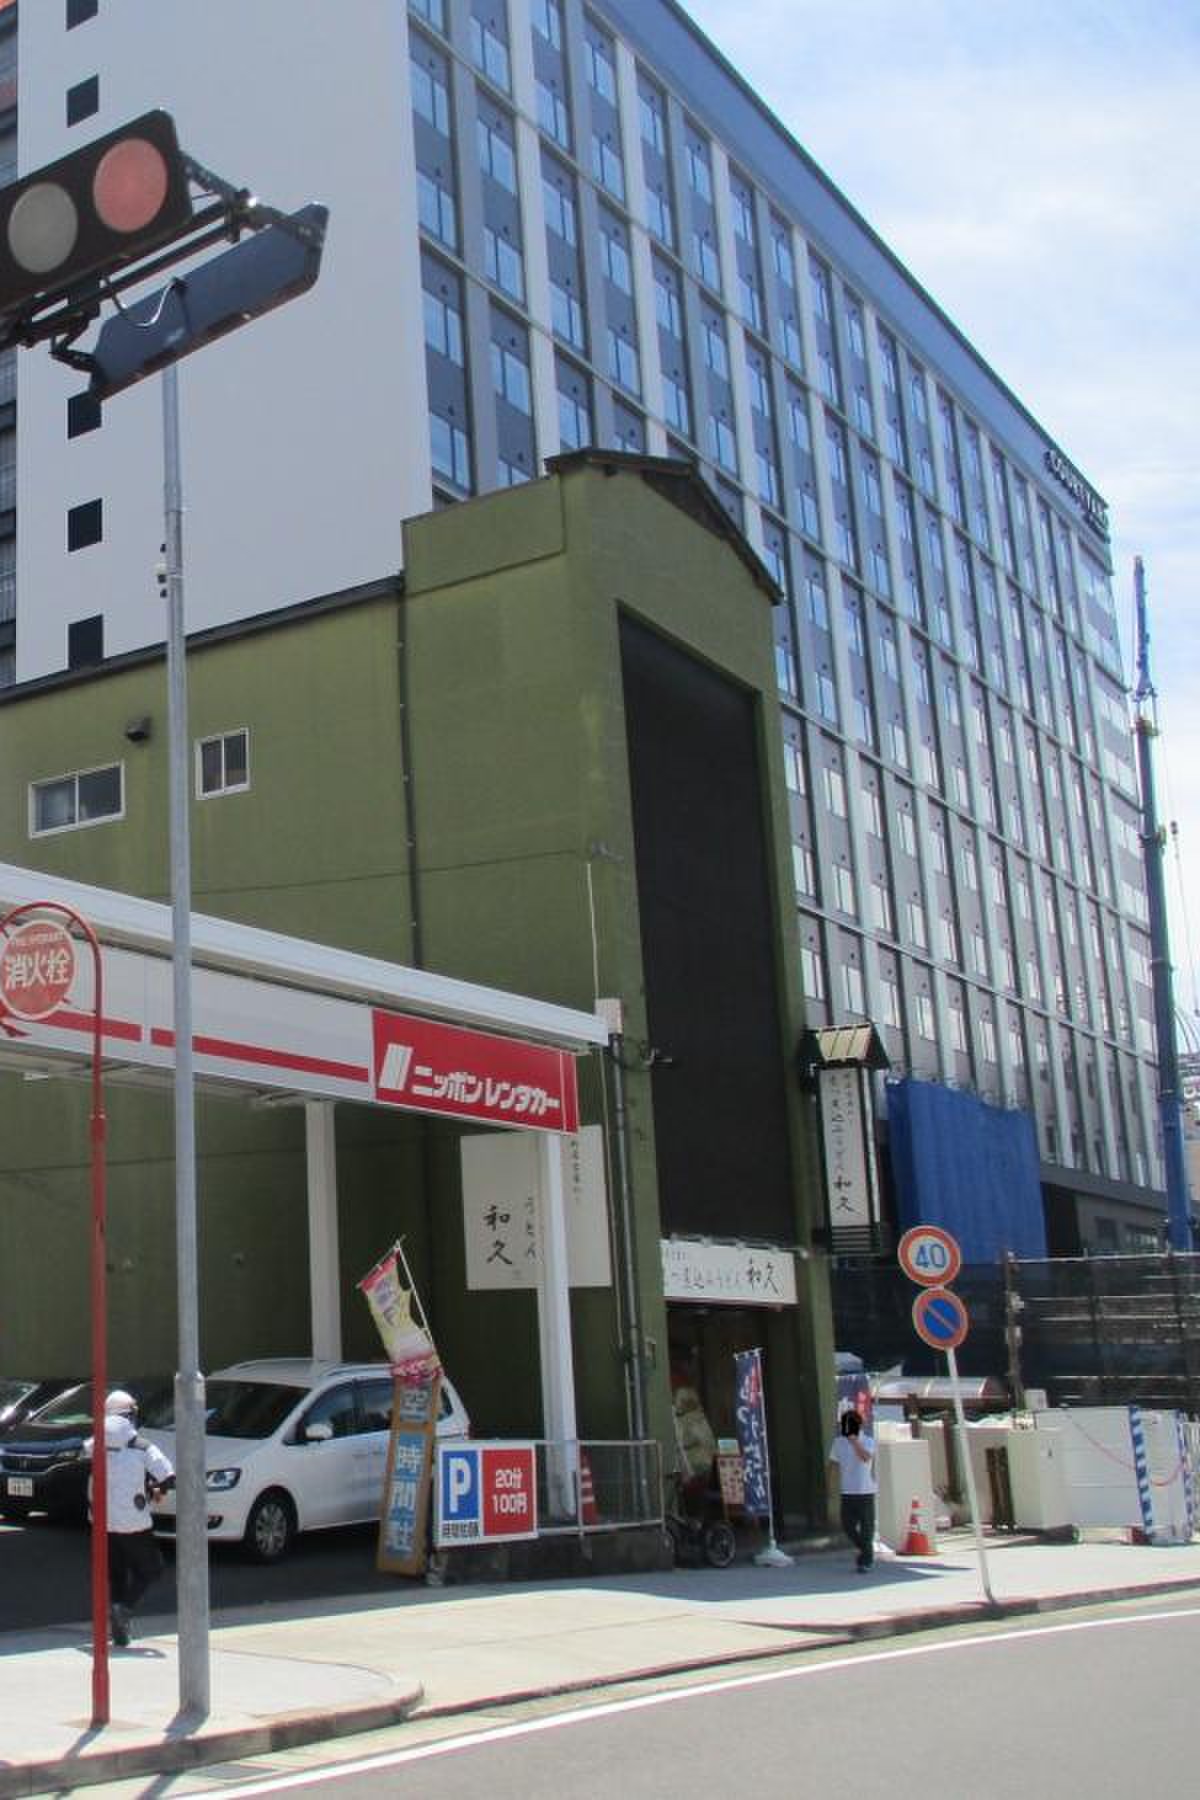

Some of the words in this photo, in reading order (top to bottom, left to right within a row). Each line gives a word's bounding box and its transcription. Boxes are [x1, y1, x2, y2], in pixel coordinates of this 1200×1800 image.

[4, 948, 69, 991] 消火栓
[411, 1064, 561, 1116] ニッポンレンタカー
[483, 1204, 513, 1265] 和久
[915, 1243, 946, 1268] 40
[449, 1457, 472, 1513] P
[495, 1467, 523, 1489] 20分
[492, 1492, 528, 1515] 100円
